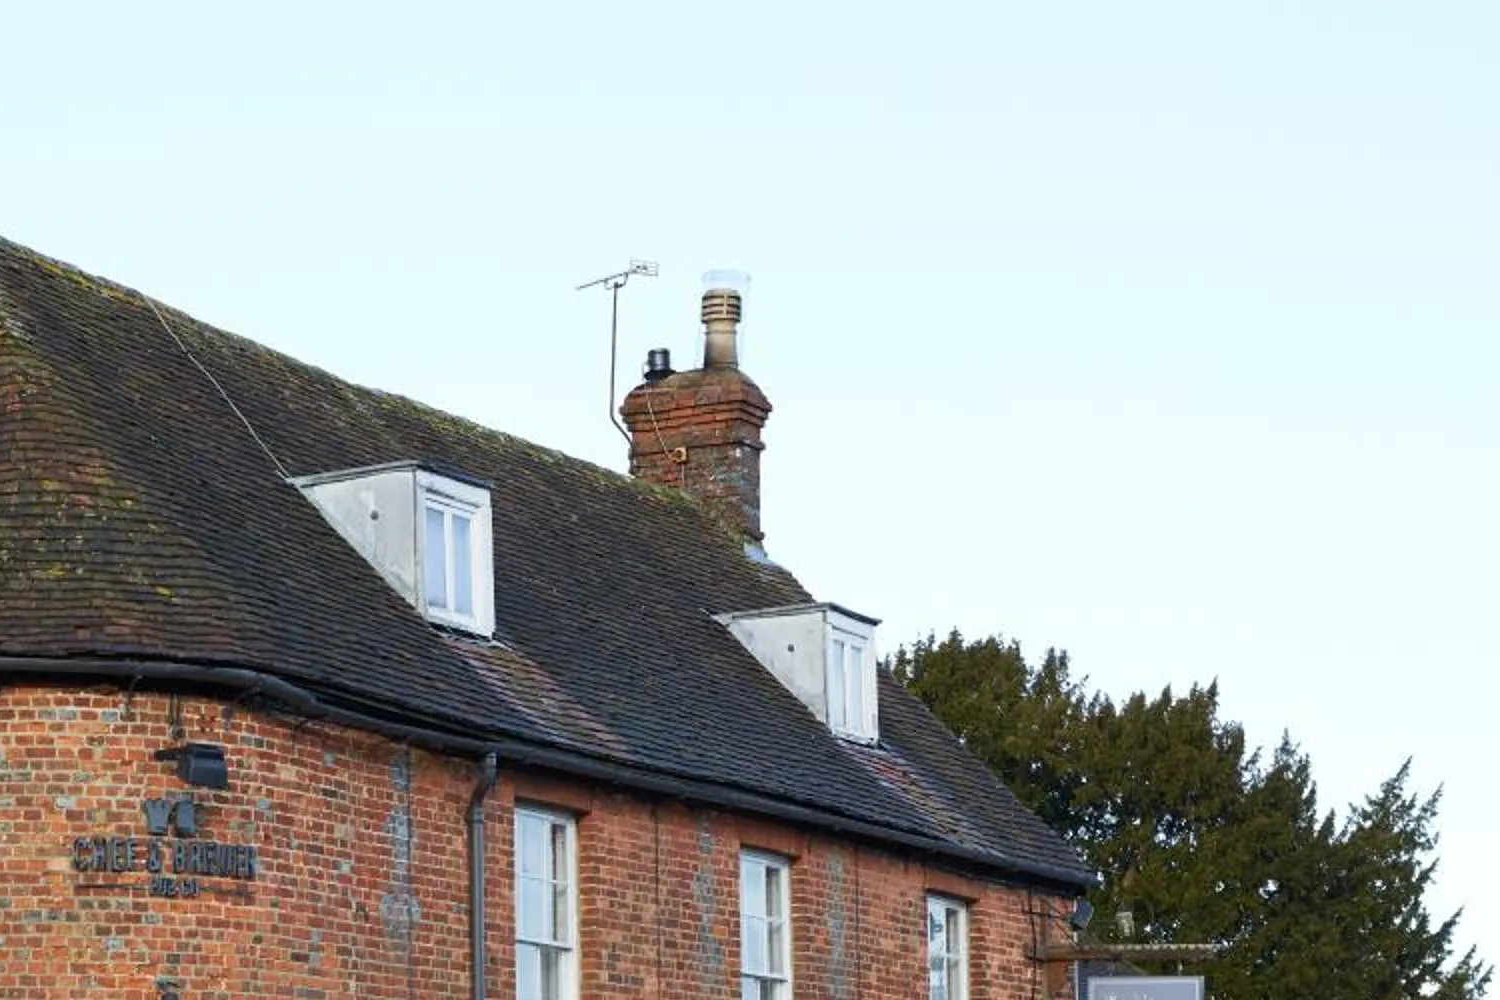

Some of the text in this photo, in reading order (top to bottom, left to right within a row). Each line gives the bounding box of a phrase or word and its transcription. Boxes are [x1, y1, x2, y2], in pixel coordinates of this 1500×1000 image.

[73, 837, 258, 880] CHEF & BREWER
